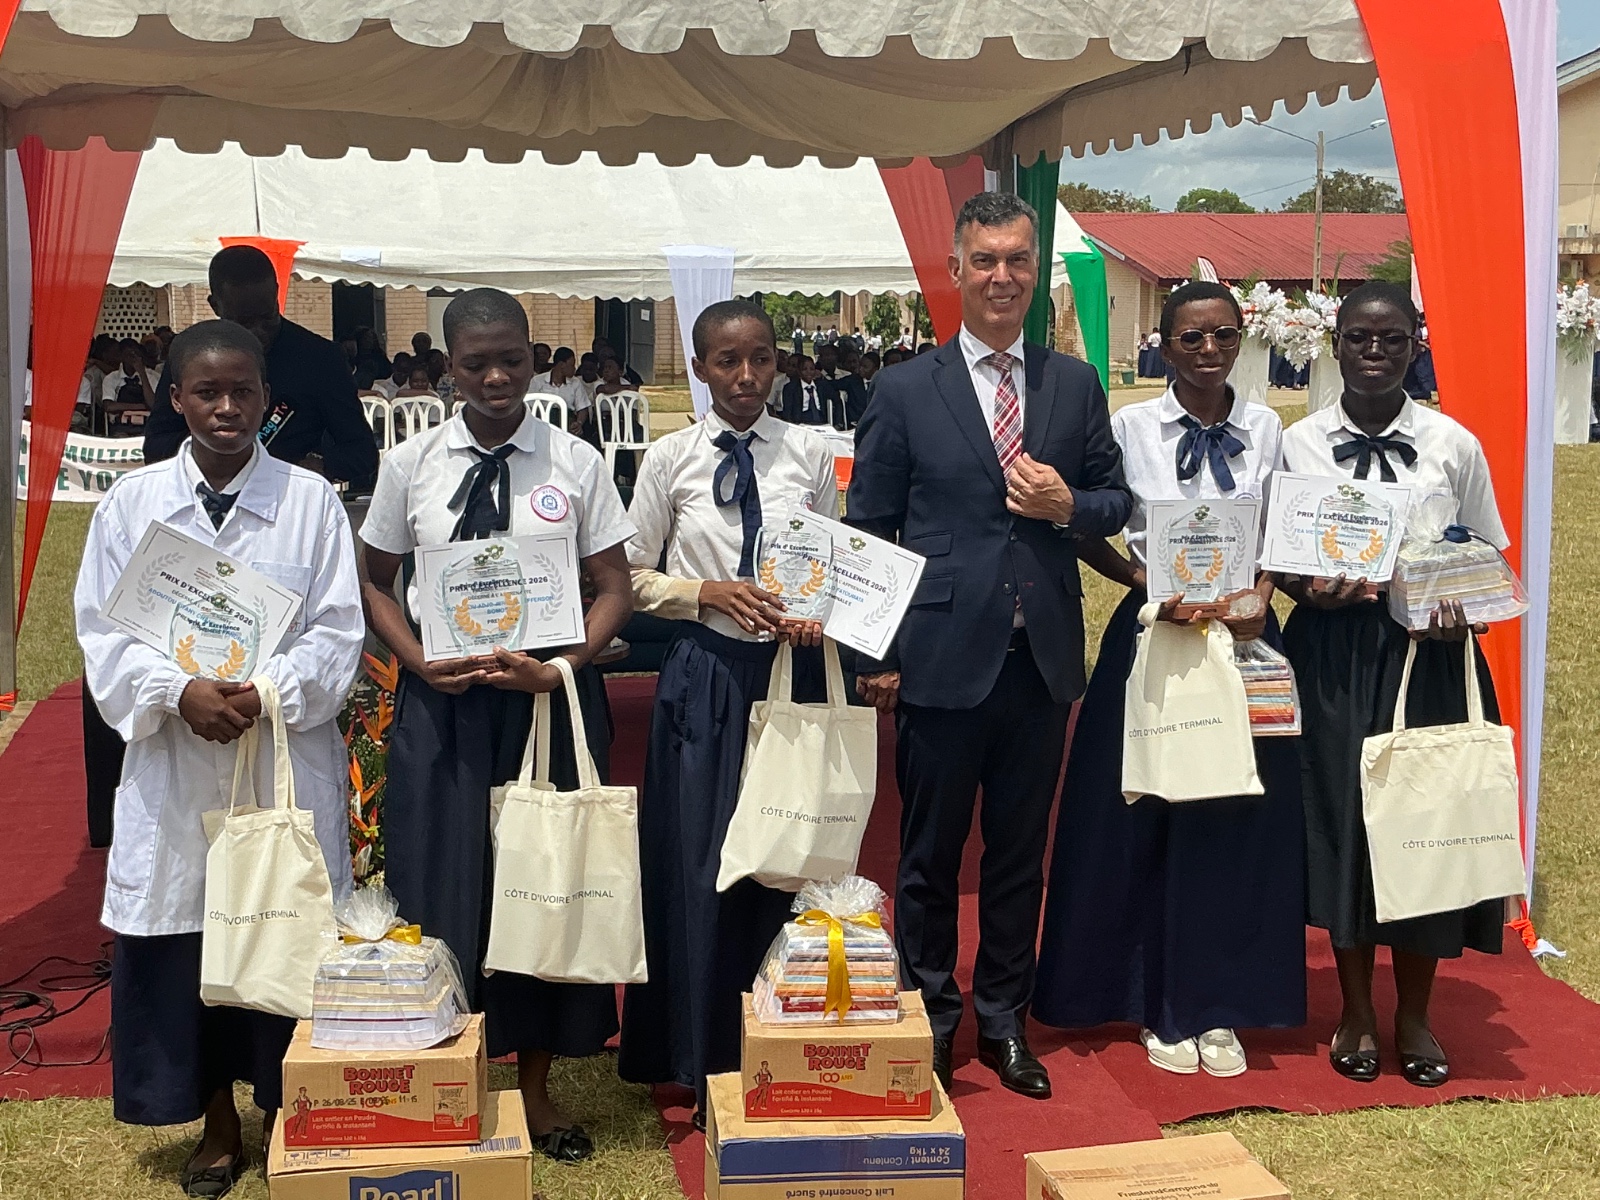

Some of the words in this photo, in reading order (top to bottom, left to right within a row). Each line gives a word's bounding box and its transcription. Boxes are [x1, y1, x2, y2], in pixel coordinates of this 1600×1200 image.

[529, 576, 548, 584] 2026
[821, 561, 870, 586] D'XCELLENCE
[871, 582, 887, 593] 2026
[160, 571, 180, 585] PRIX
[234, 612, 254, 626] 2026
[1144, 724, 1177, 736] D'IVOIRE
[1179, 717, 1223, 730] TERMINAL
[760, 806, 784, 817] CÔTE
[786, 811, 821, 824] D'IVOIRE
[823, 815, 857, 823] TERMINAL
[1402, 840, 1426, 849] CÔTE
[1428, 838, 1467, 848] D'IVOIRE
[1469, 833, 1515, 845] TERMINAL
[504, 889, 528, 899] CÔTE
[531, 893, 570, 904] D'IVOIRE
[225, 915, 256, 925] IVOIRE
[804, 1043, 871, 1057] BONNET
[808, 1056, 866, 1071] ROUGE
[344, 1065, 415, 1081] BONNET
[820, 1072, 840, 1083] 100
[349, 1080, 410, 1095] ROUGE
[909, 1146, 926, 1156] 1kg
[939, 1146, 951, 1155] 24
[863, 1156, 903, 1166] Contenu
[911, 1155, 950, 1165] Content
[785, 1189, 816, 1199] Sucré
[819, 1188, 872, 1198] Concentré
[875, 1187, 894, 1197] Lait
